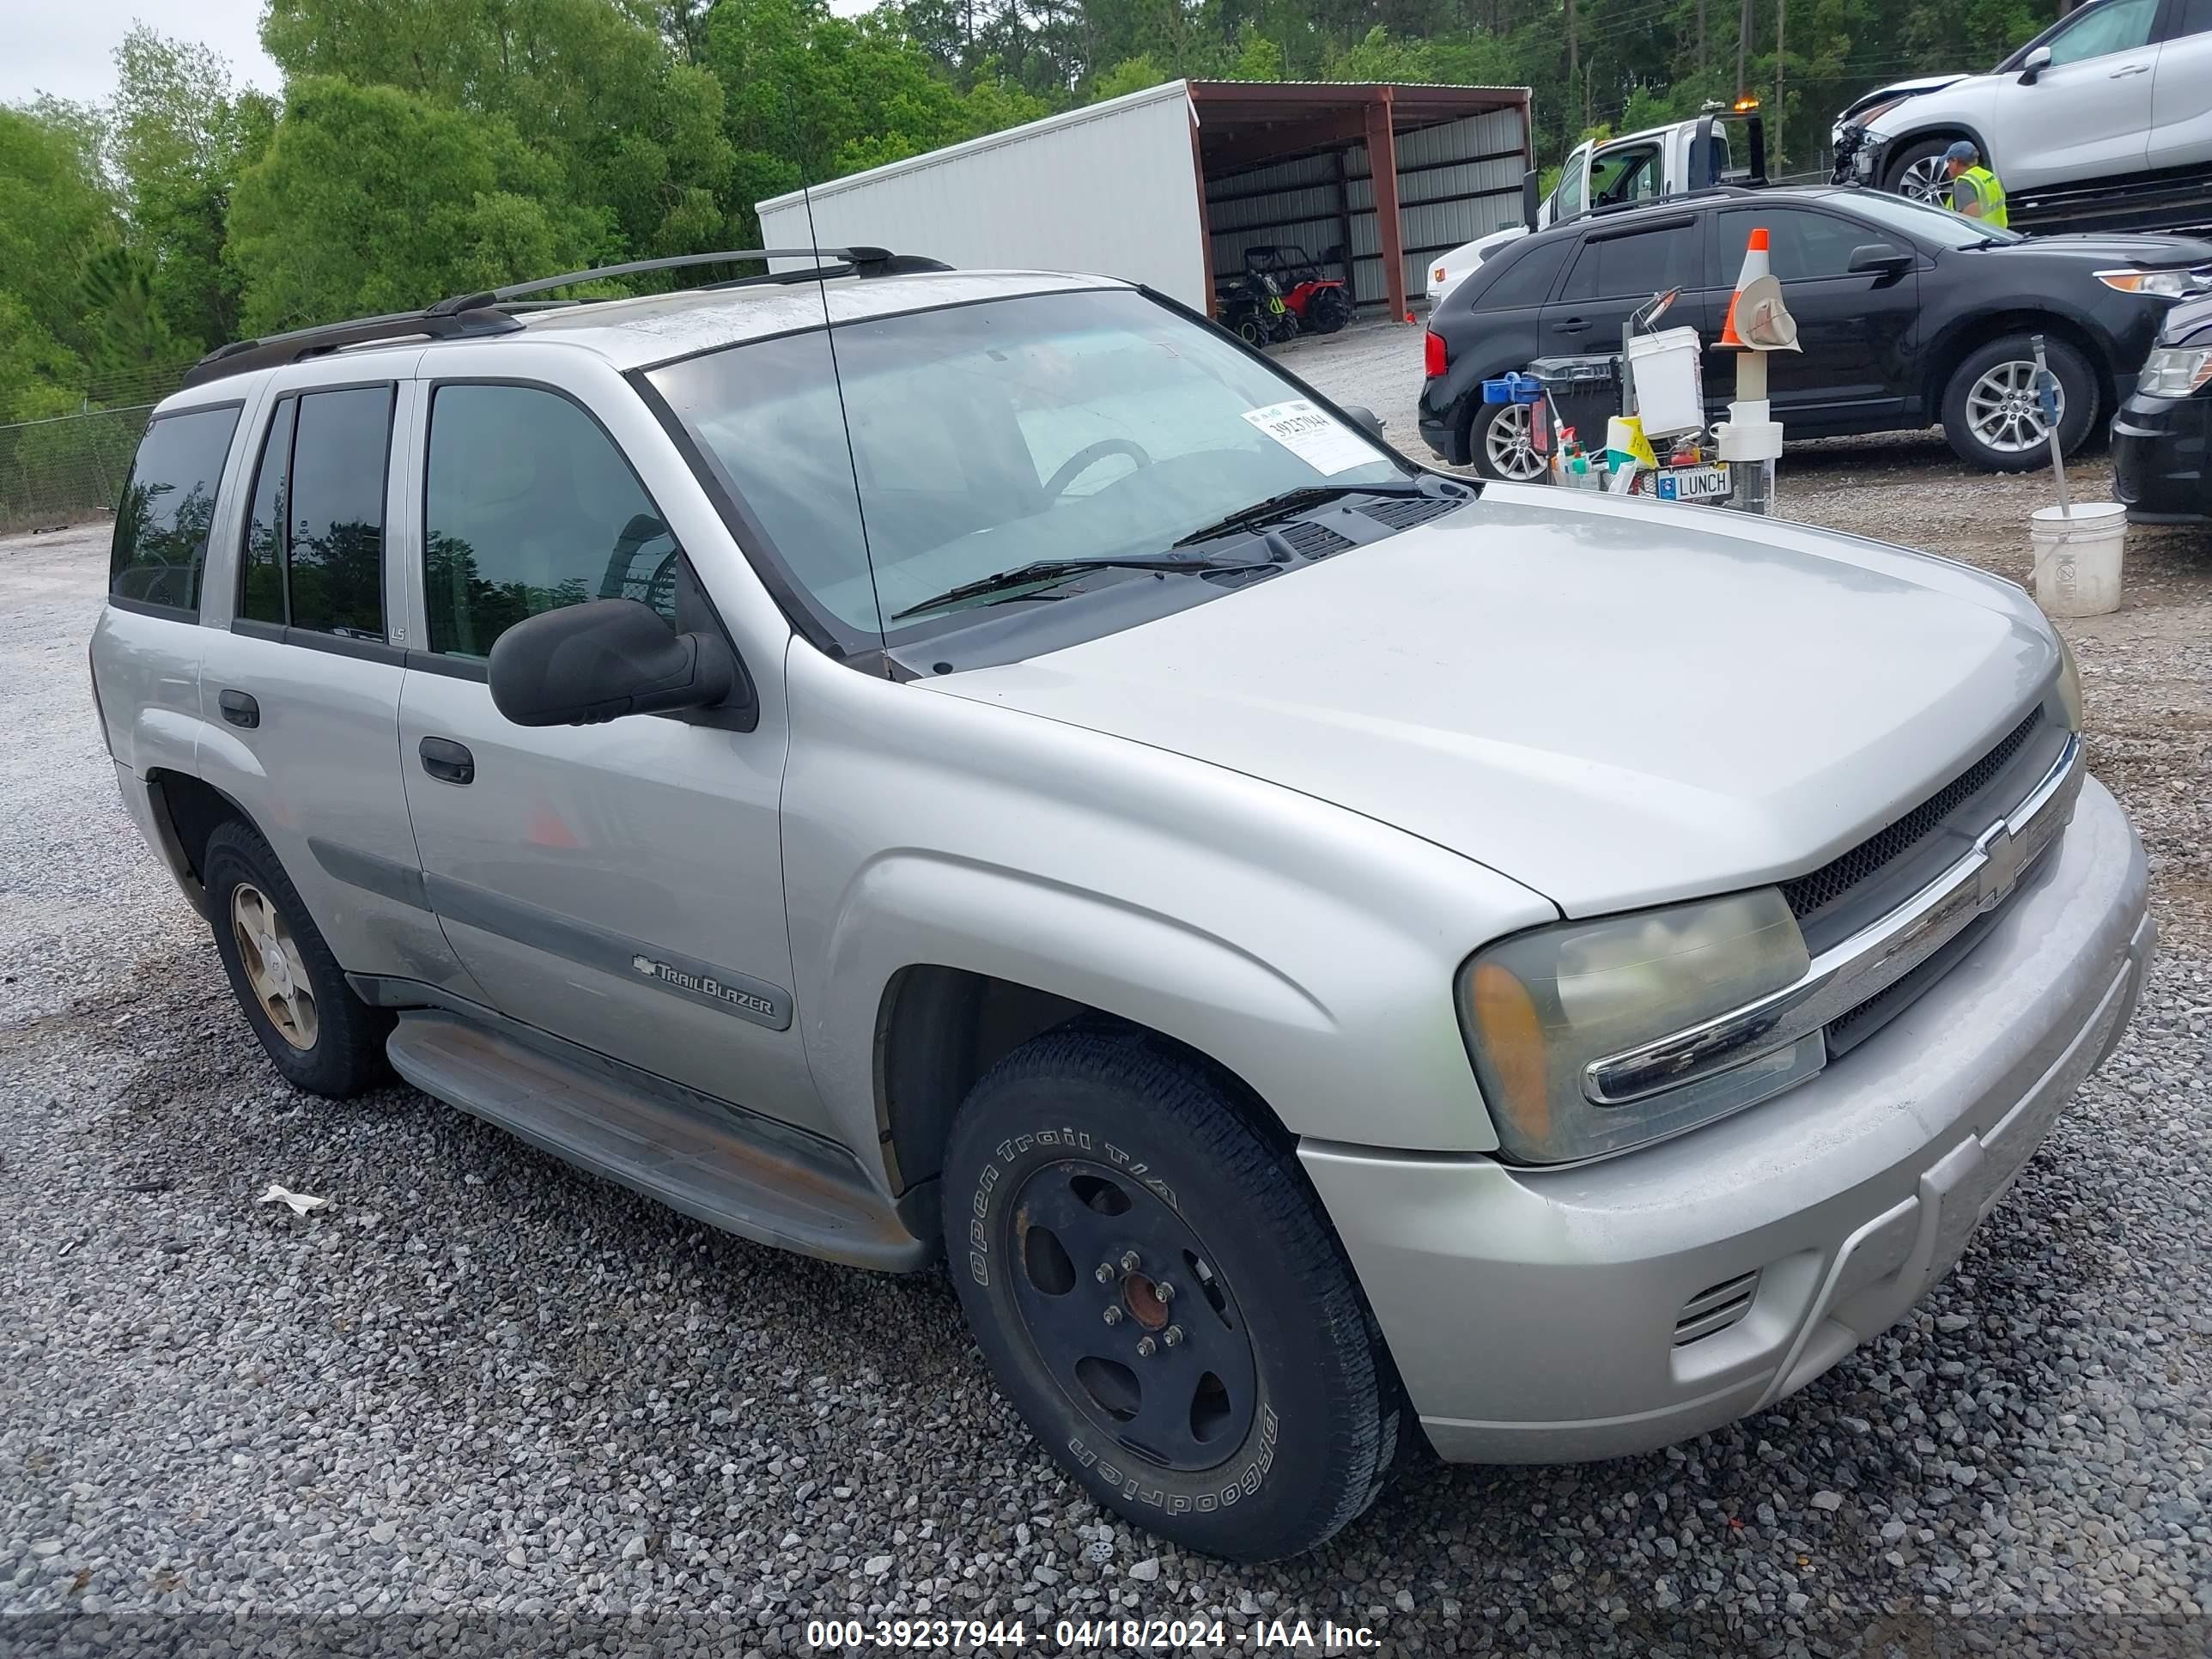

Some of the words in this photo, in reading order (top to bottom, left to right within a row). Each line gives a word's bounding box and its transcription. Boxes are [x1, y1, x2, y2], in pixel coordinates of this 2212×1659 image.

[1270, 415, 1329, 436] 39237944
[1680, 472, 1726, 495] LUNCH
[392, 626, 405, 641] LS
[969, 1164, 1000, 1286] Open
[996, 1127, 1091, 1162] Trail
[1105, 1143, 1177, 1209] T/A
[1068, 1402, 1279, 1516] BFGoodrich
